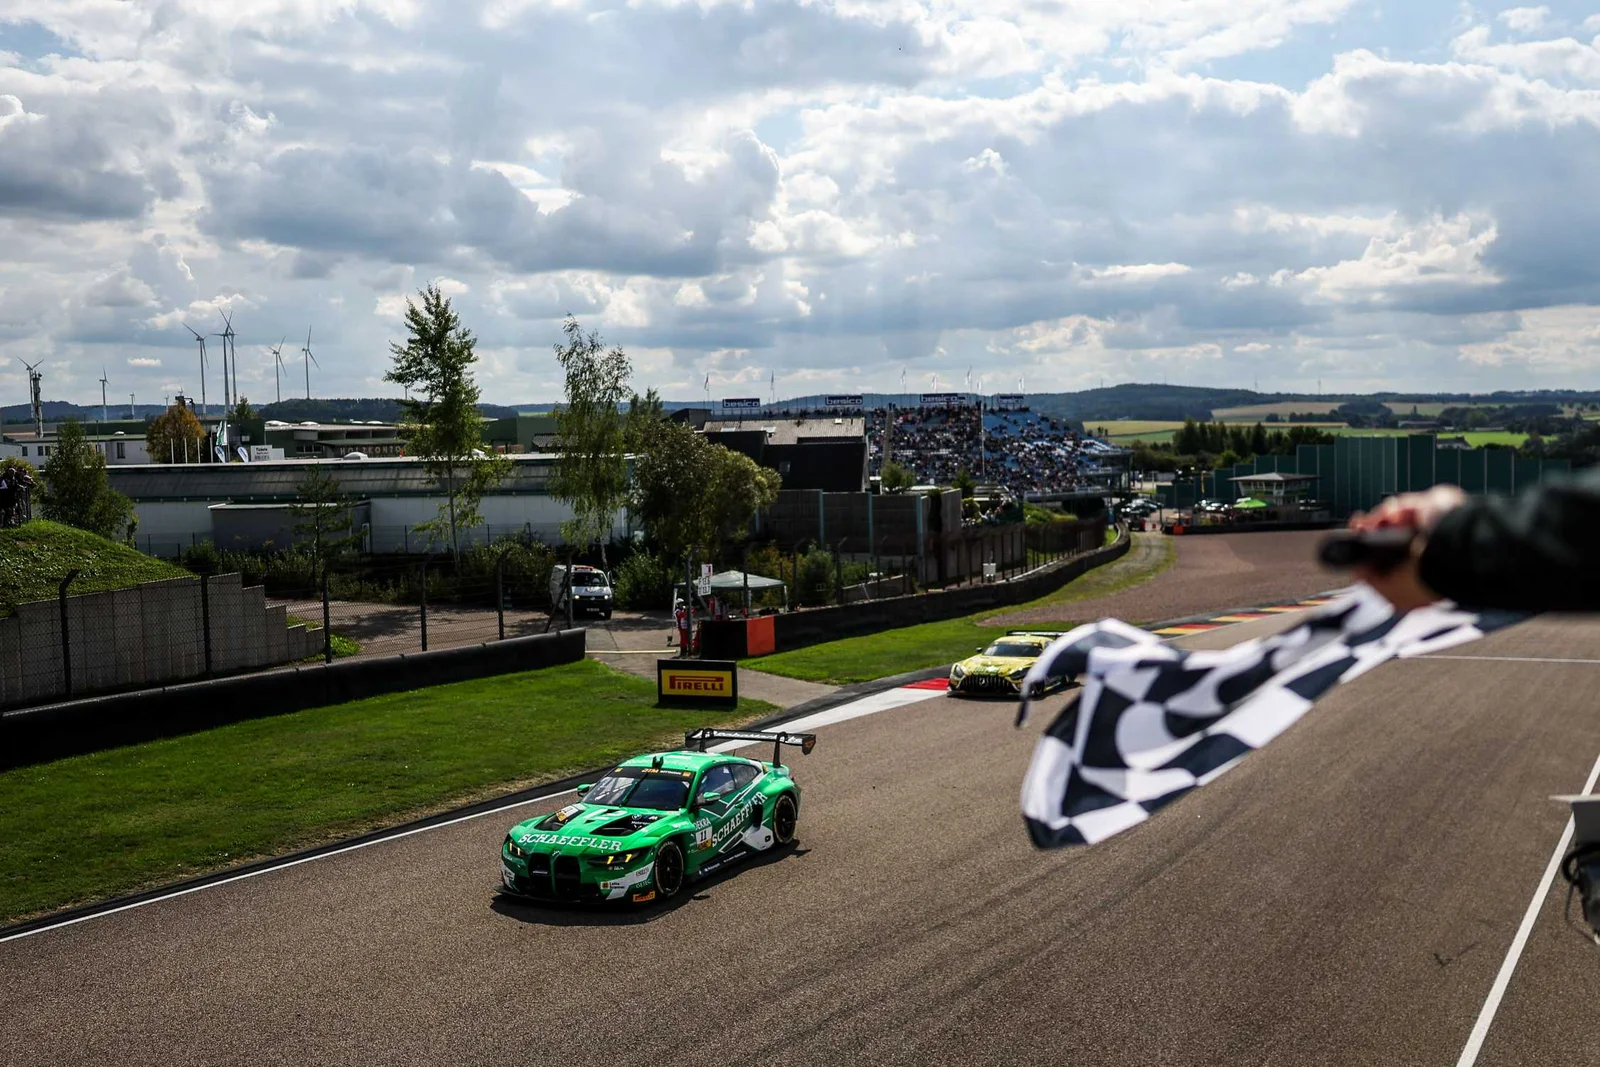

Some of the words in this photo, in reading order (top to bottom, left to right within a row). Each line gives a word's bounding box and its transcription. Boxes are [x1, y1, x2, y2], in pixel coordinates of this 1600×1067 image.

[826, 397, 863, 405] besico
[922, 395, 958, 403] besico
[669, 676, 724, 691] PIRELLI
[694, 817, 711, 830] DEKRA
[518, 833, 622, 851] SCHAEFFLER
